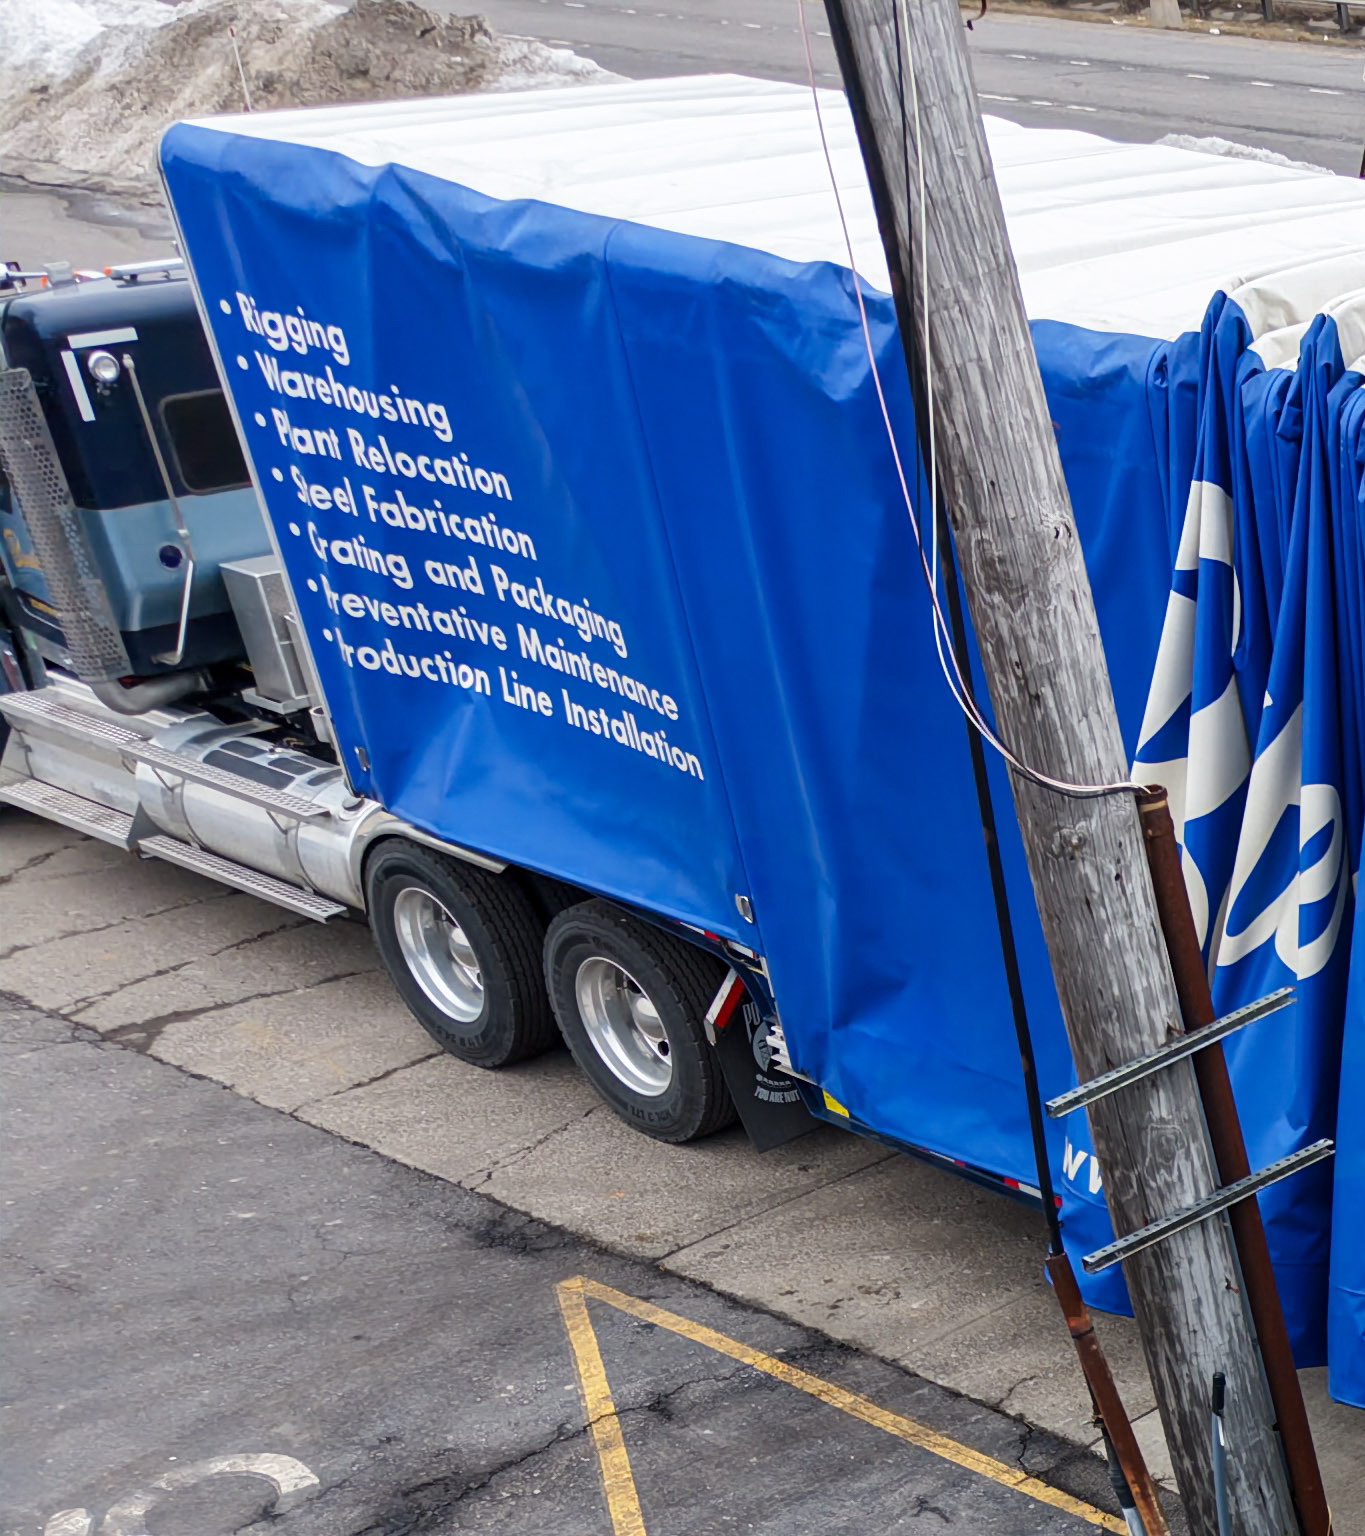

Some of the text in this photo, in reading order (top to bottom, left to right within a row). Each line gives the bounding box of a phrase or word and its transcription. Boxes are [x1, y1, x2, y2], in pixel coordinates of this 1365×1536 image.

[236, 291, 350, 366] Rigging
[254, 350, 453, 442] Warehousing
[271, 407, 512, 500] Plant Relocation
[290, 465, 537, 561] Seel Fabrication
[424, 556, 485, 595] and
[490, 564, 628, 659] Packaging
[517, 623, 678, 720] Maintenance
[499, 666, 553, 717] Line
[561, 688, 704, 780] Installation
